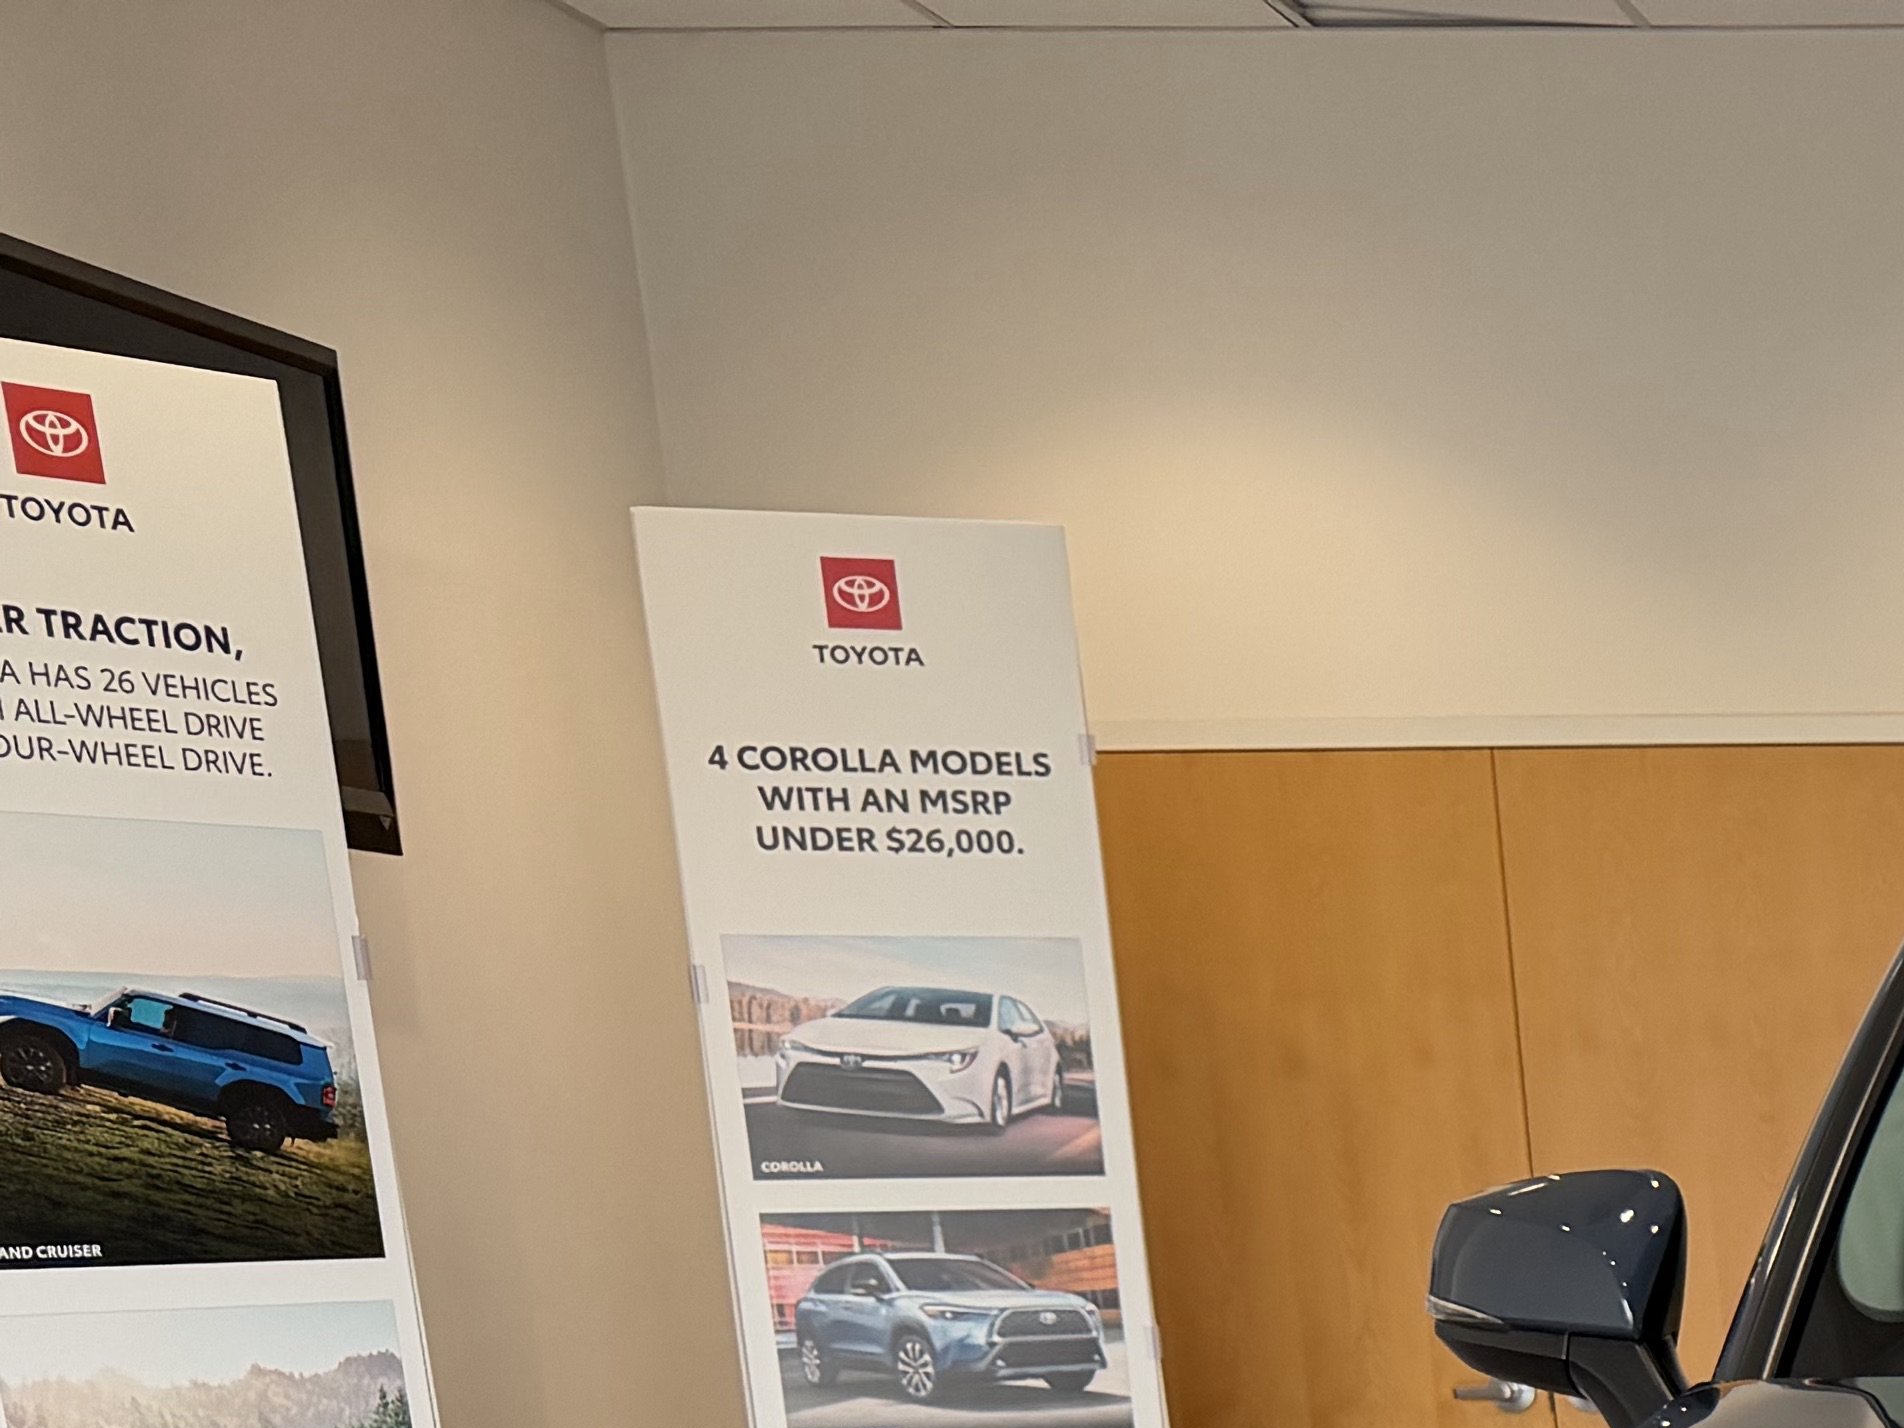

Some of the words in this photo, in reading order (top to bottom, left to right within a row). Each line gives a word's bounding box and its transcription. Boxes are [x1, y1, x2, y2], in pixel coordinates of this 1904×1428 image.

[0, 494, 135, 533] TOYOTA
[35, 607, 243, 661] TRACTION,
[812, 644, 925, 667] TOYOTA
[28, 661, 91, 690] HAS
[100, 668, 135, 694] 26
[142, 671, 278, 707] VEHICLES
[14, 698, 178, 734] ALL-WHEEL
[184, 711, 265, 741] DRIVE
[182, 748, 273, 778] DRIVE.
[708, 744, 728, 770] 4
[736, 745, 902, 774] COROLLA
[909, 749, 1052, 777] MODELS
[757, 785, 851, 812] WITH
[860, 788, 911, 814] AN
[919, 790, 1013, 816] MSRP
[755, 825, 880, 852] UNDER
[886, 826, 1026, 858] $26,000.
[760, 1160, 825, 1174] COROLLA
[36, 1244, 103, 1259] CRUISER
